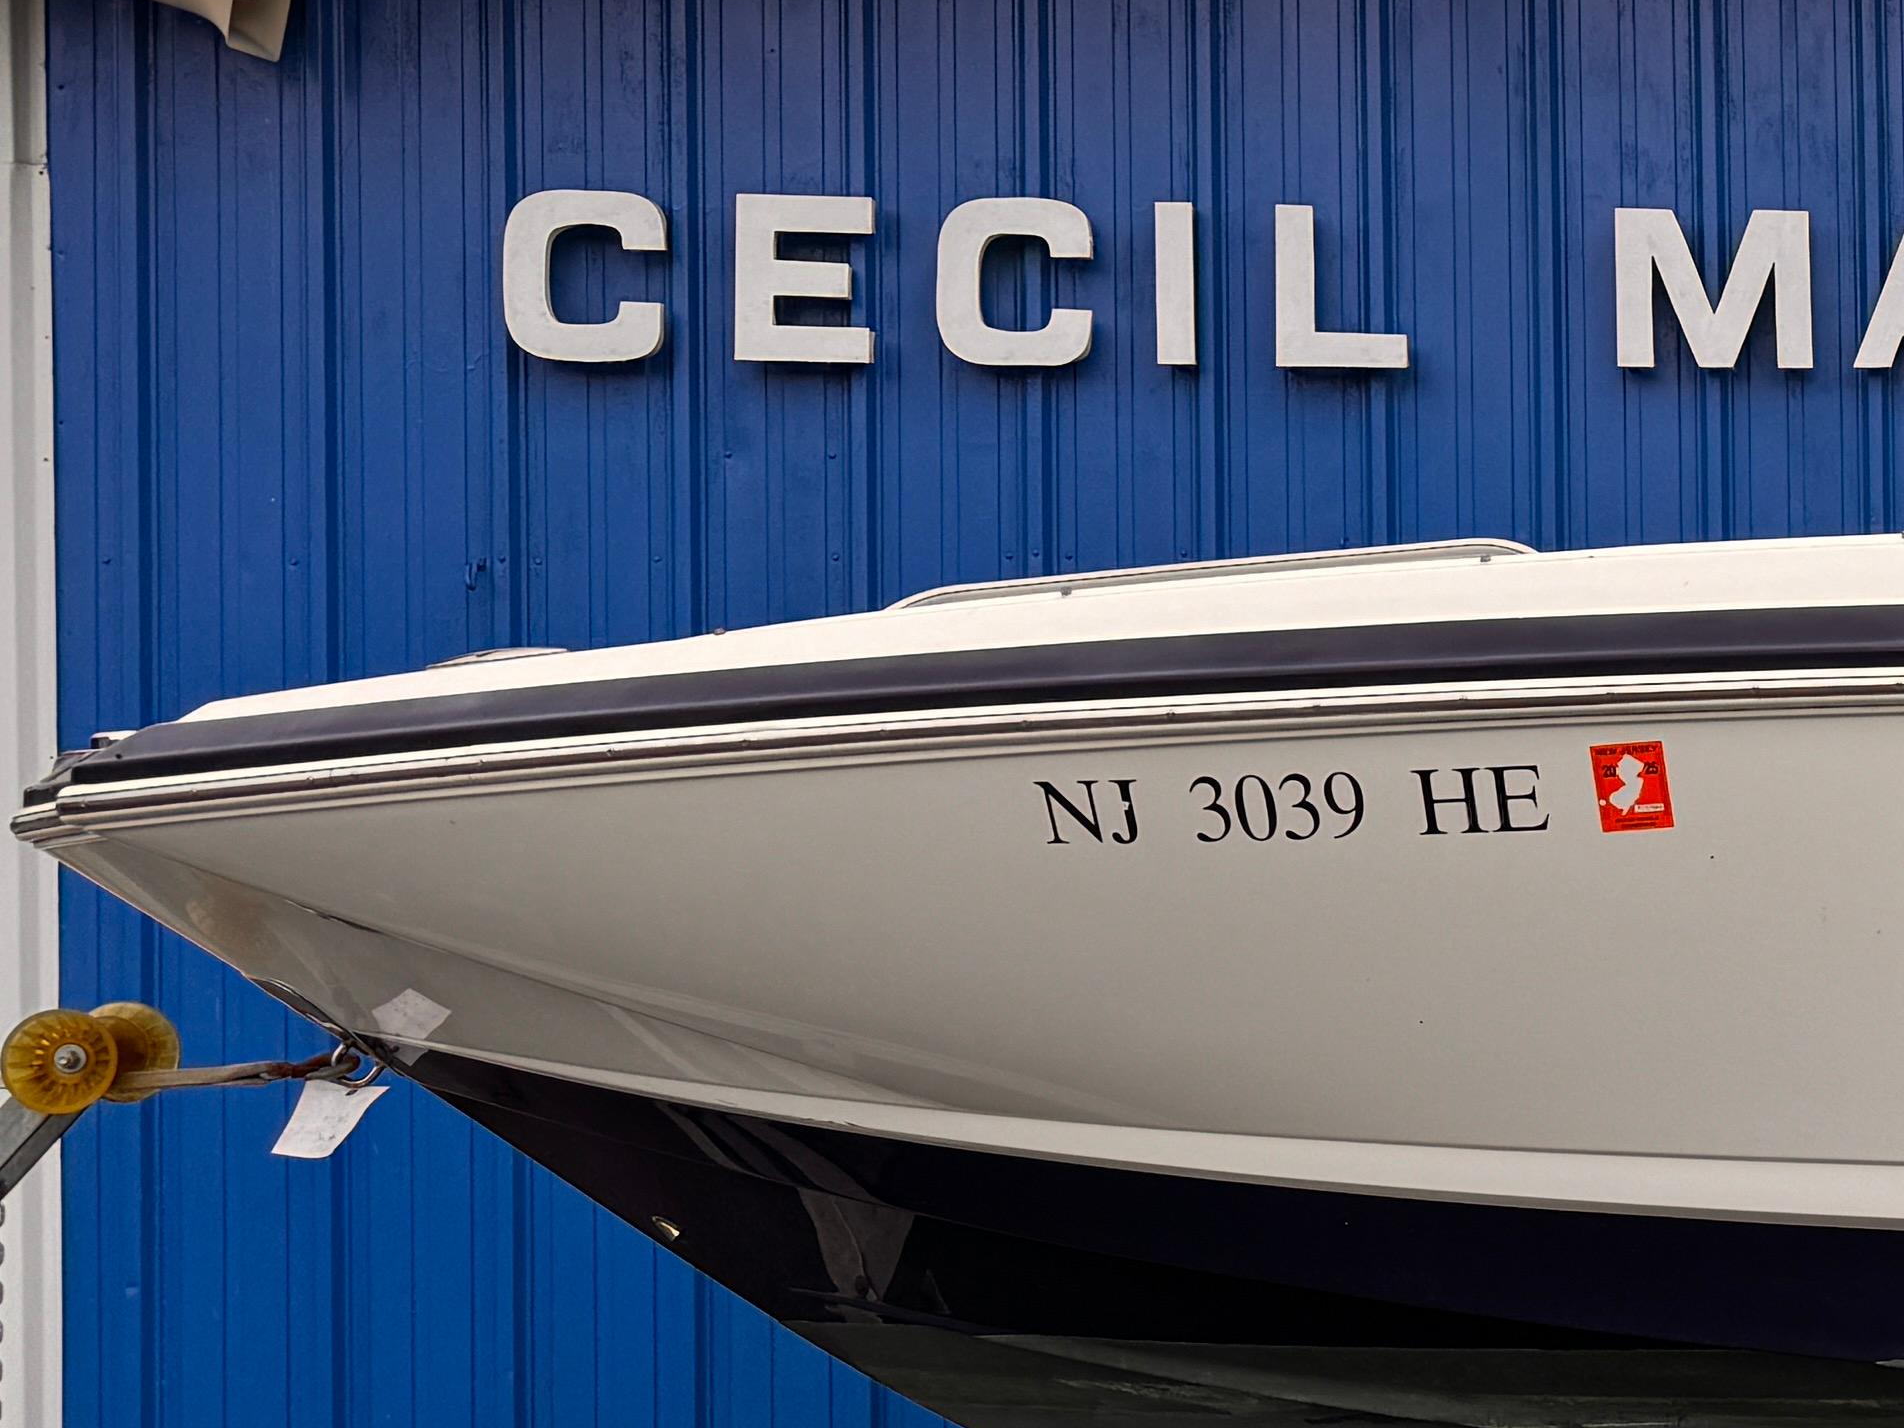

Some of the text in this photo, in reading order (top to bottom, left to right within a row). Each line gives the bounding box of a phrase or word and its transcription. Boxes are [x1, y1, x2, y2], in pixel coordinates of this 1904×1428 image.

[503, 189, 1409, 369] CECIL
[1033, 764, 1550, 845] NJ 3039 HE
